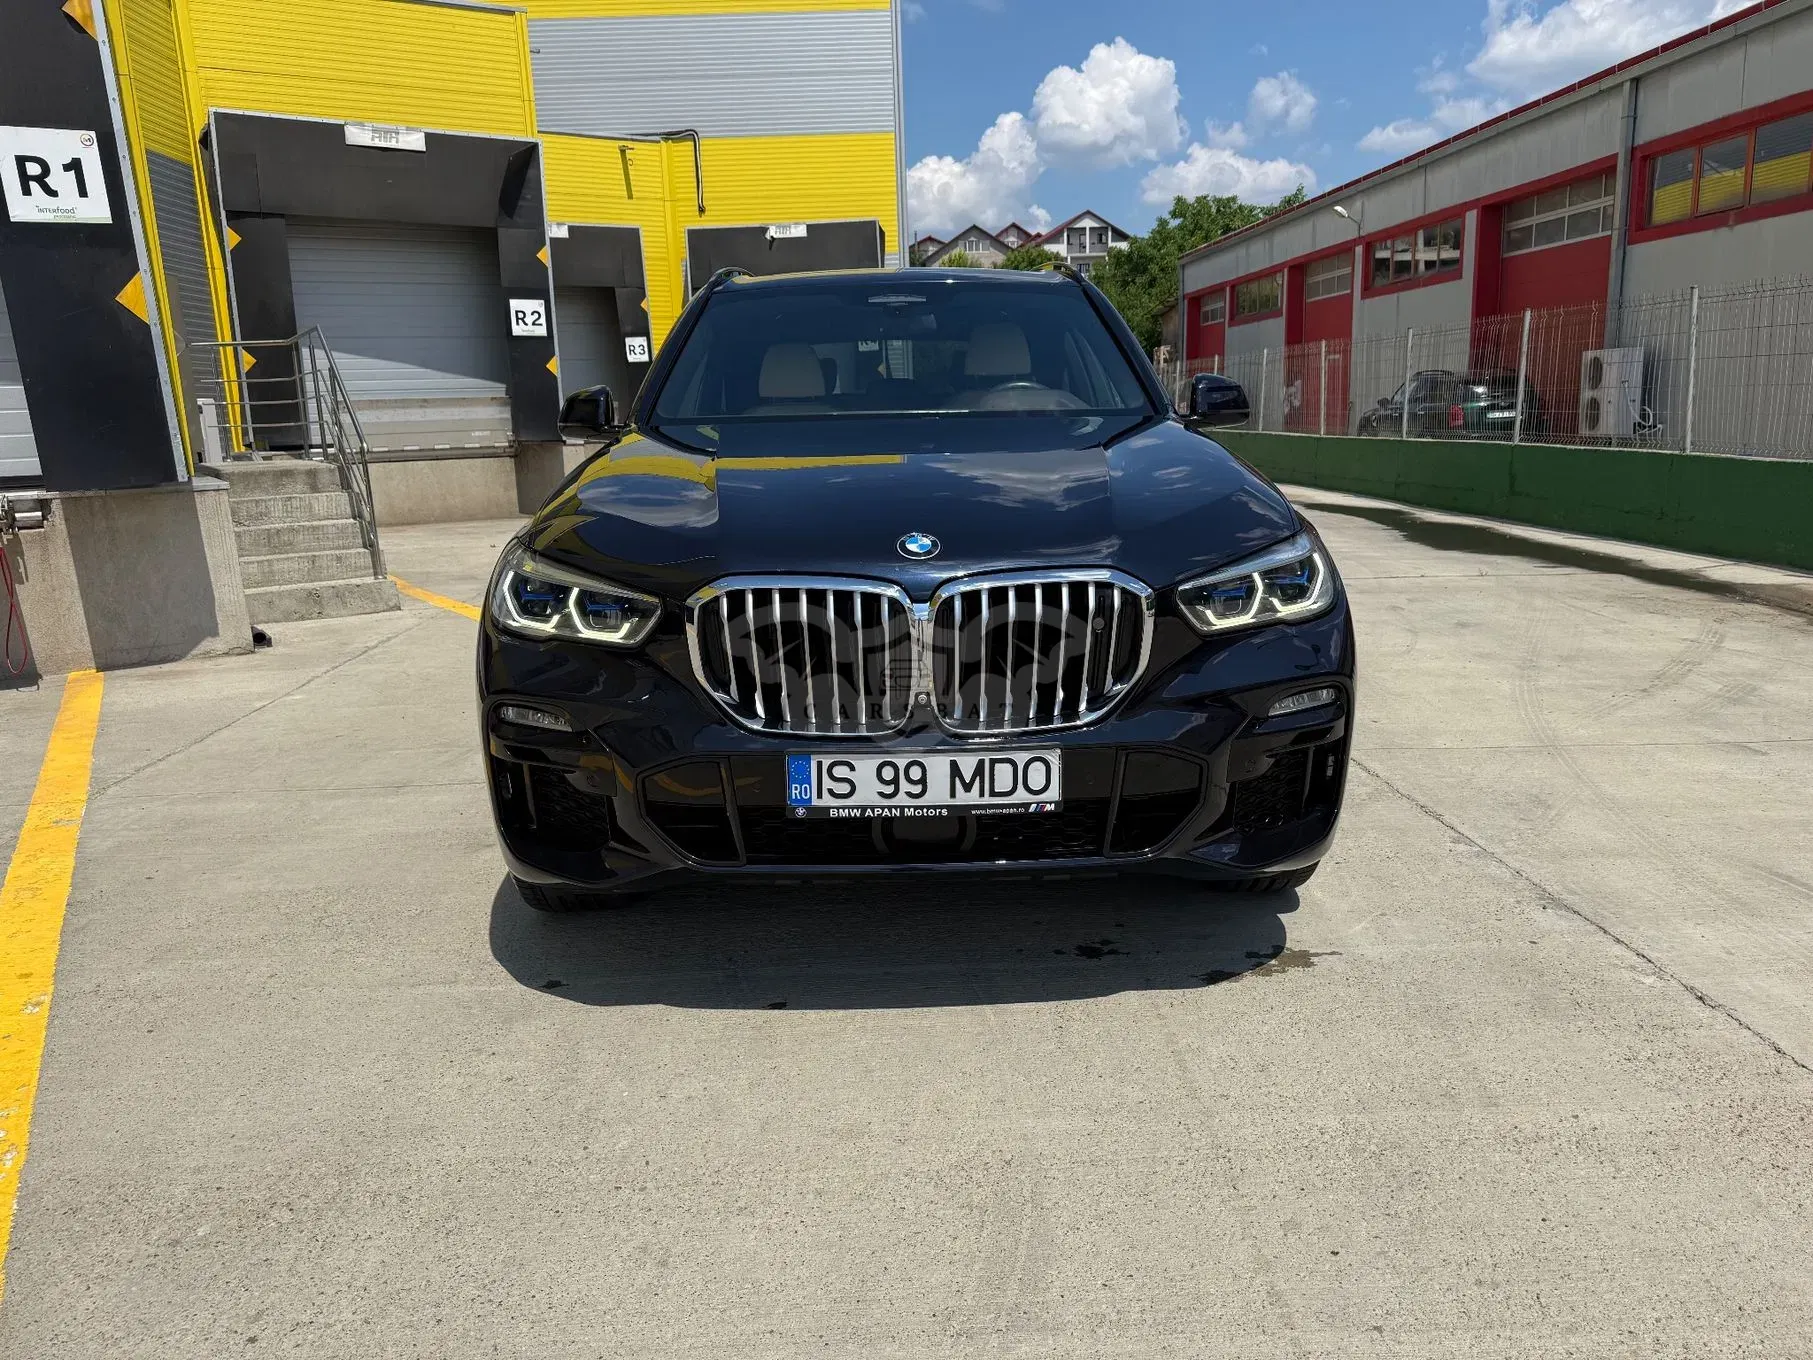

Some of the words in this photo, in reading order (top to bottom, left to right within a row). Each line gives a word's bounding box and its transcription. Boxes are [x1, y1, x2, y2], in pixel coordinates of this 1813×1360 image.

[14, 154, 89, 198] R1
[515, 310, 543, 326] R2
[628, 344, 646, 356] R3
[816, 760, 857, 800] IS
[876, 759, 928, 800] 99
[949, 755, 1052, 799] MDO
[792, 783, 811, 800] RO
[829, 808, 861, 817] BMW
[864, 807, 900, 817] APAN
[904, 806, 948, 817] Motors
